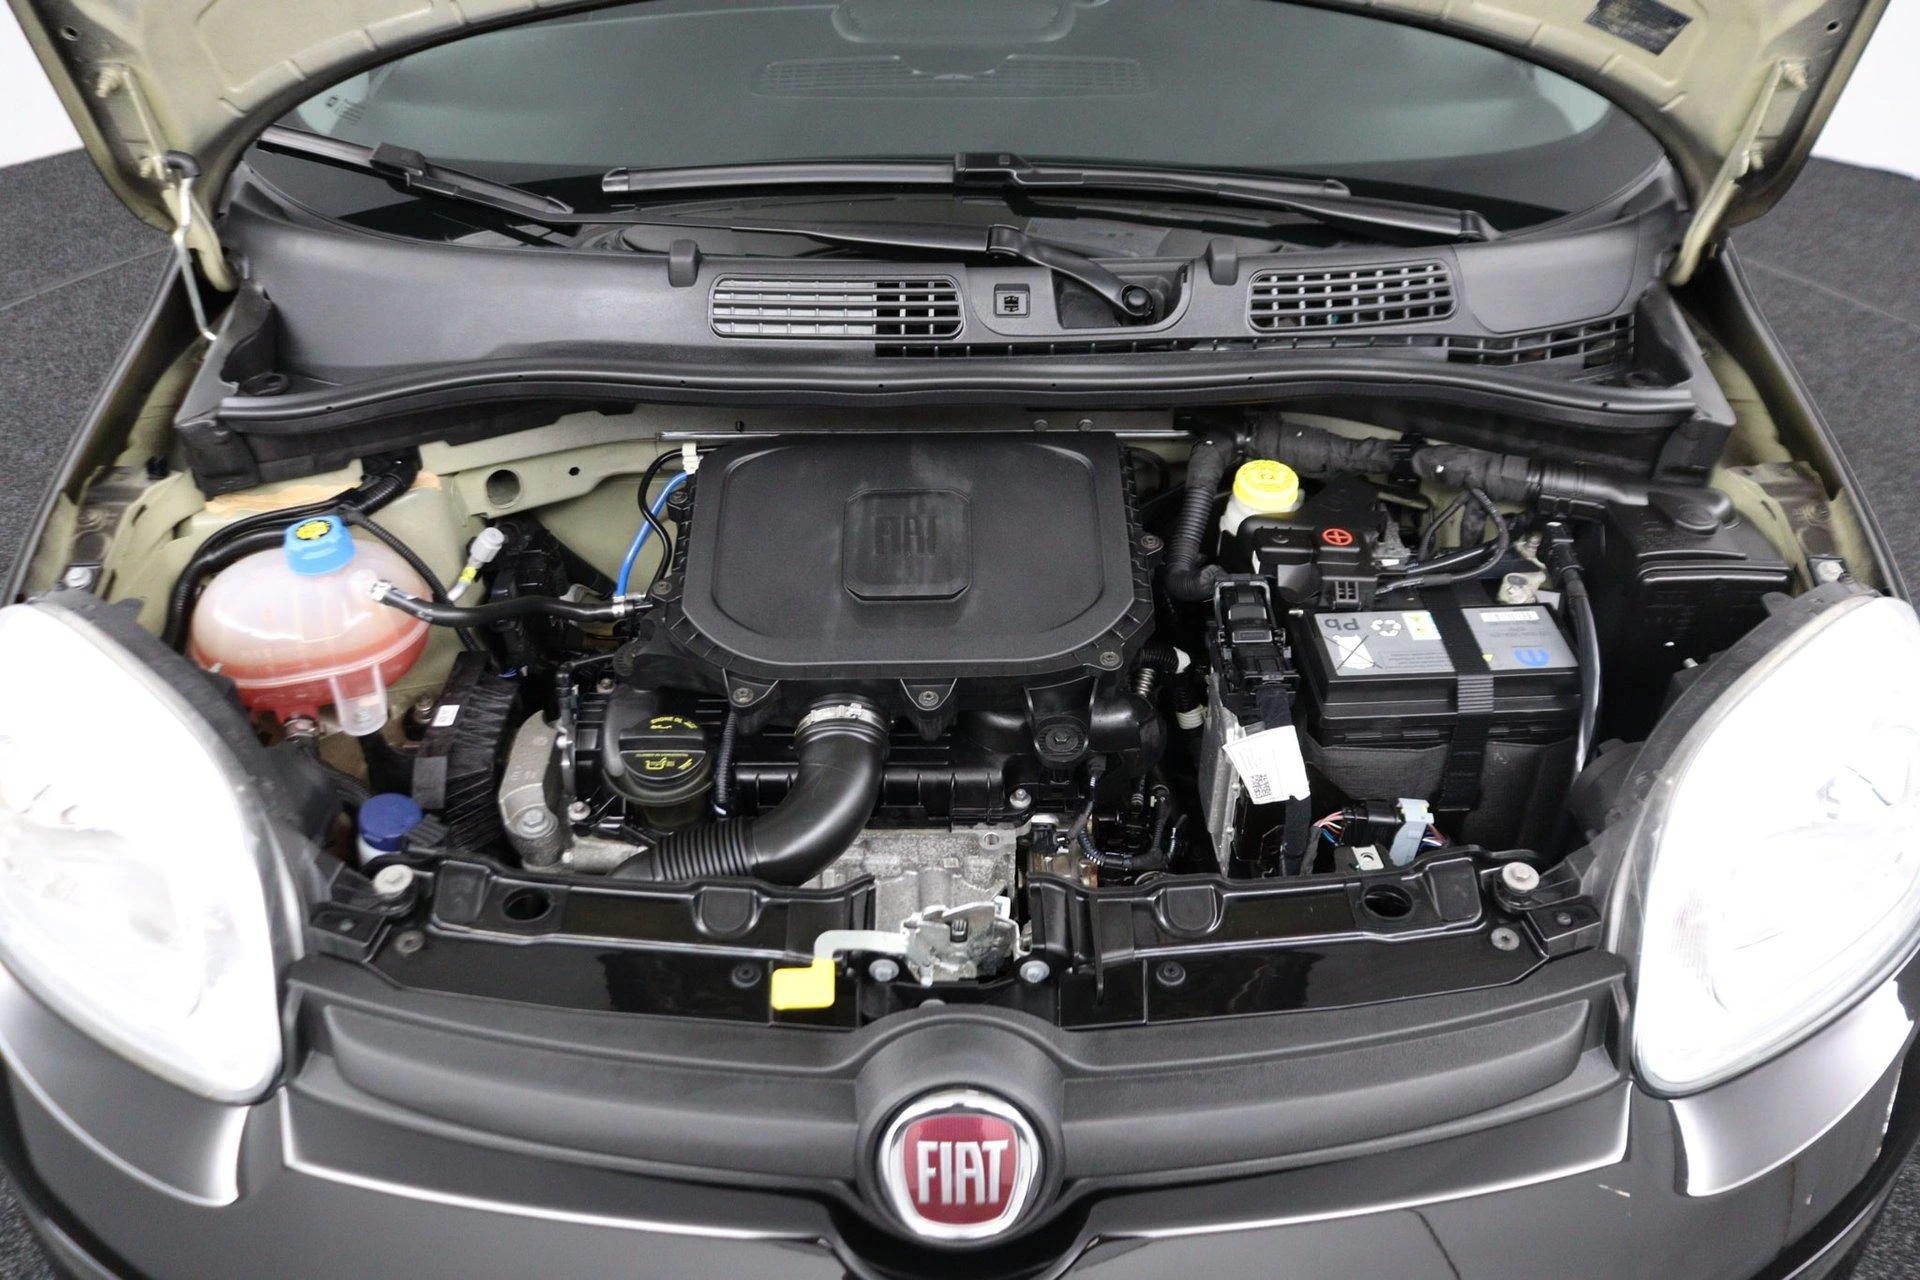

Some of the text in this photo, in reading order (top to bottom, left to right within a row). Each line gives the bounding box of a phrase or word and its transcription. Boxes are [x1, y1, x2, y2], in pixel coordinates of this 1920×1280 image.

[873, 516, 941, 555] FIAT
[1324, 617, 1361, 631] Pb
[917, 1139, 1009, 1205] FIAT
